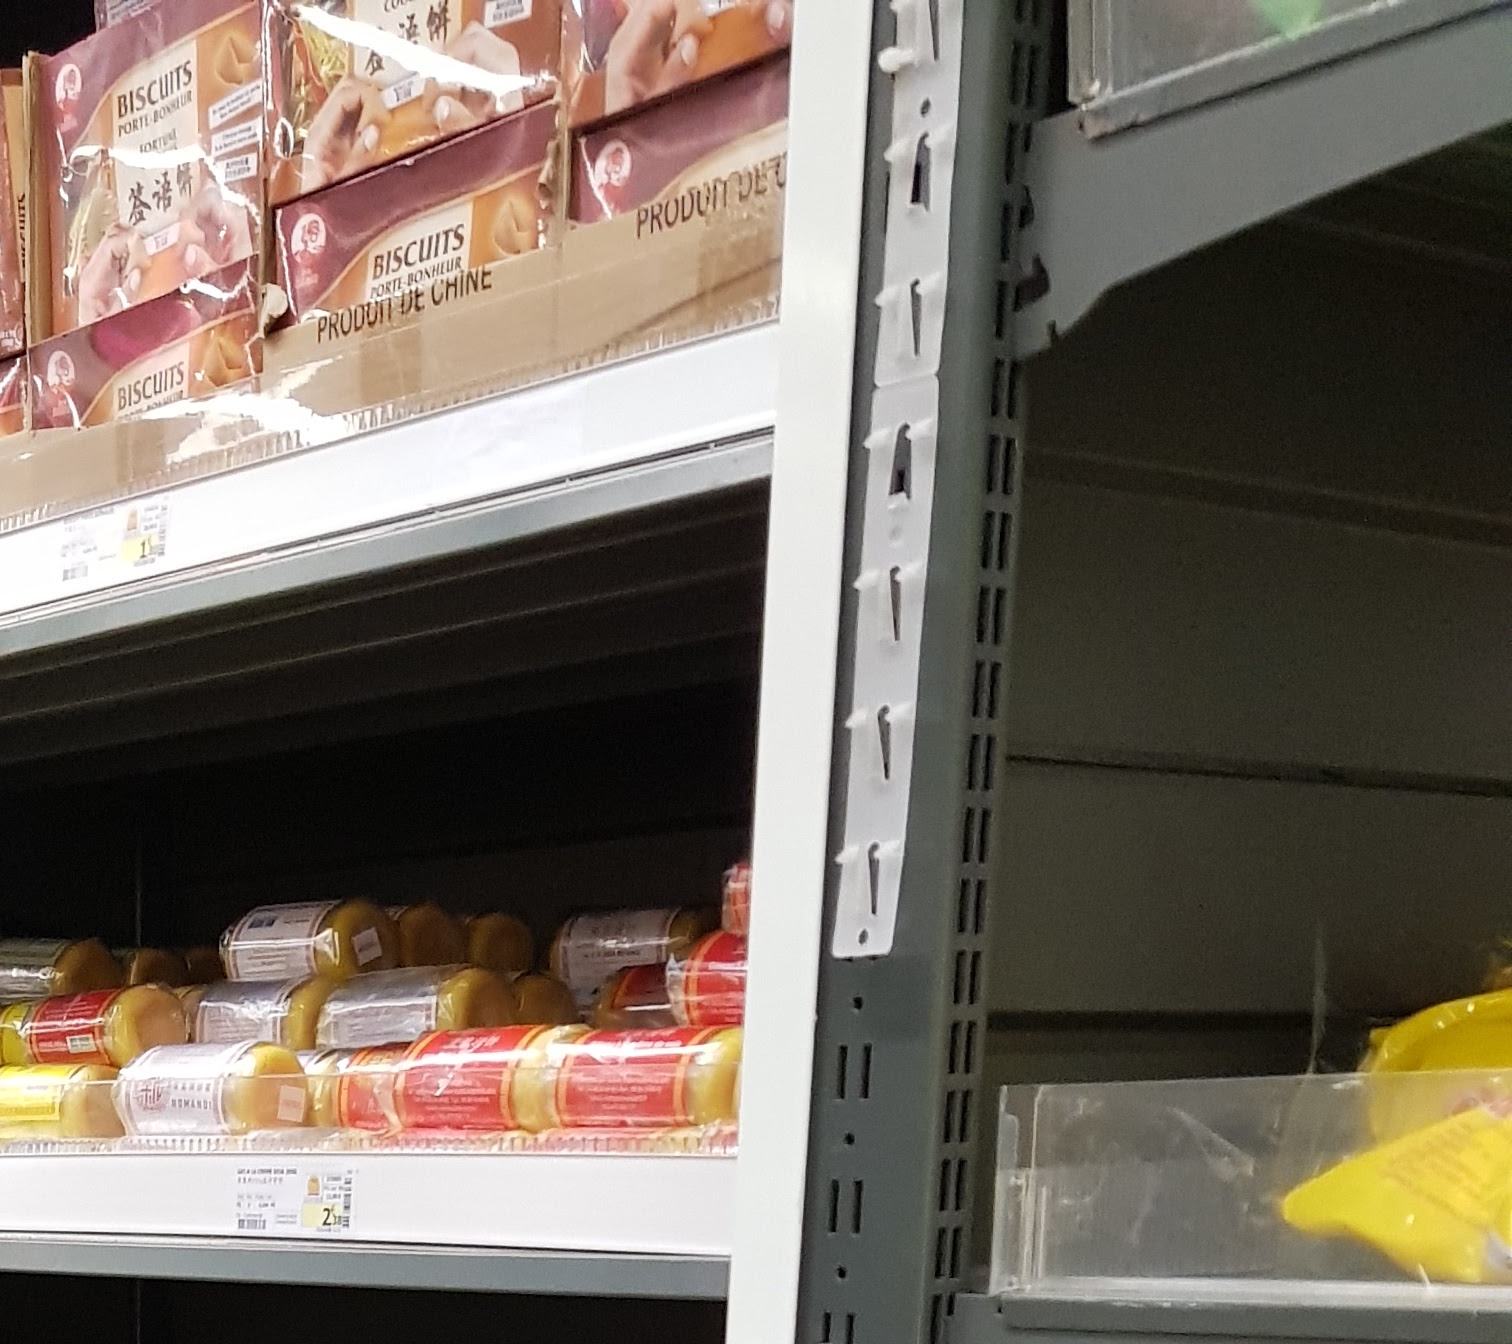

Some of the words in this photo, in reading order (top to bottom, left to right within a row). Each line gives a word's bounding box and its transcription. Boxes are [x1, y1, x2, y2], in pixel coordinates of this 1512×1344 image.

[117, 61, 192, 119] BISCUITS
[118, 90, 192, 137] PORTE-BONHEUR
[637, 178, 728, 240] PRODUIT
[371, 256, 462, 300] PORTE-BONHEUR
[373, 224, 465, 281] BISCUITS
[318, 296, 392, 344] PRODUIT
[401, 288, 425, 314] DE
[431, 266, 492, 307] CHINE
[118, 362, 184, 411] BISCUITS
